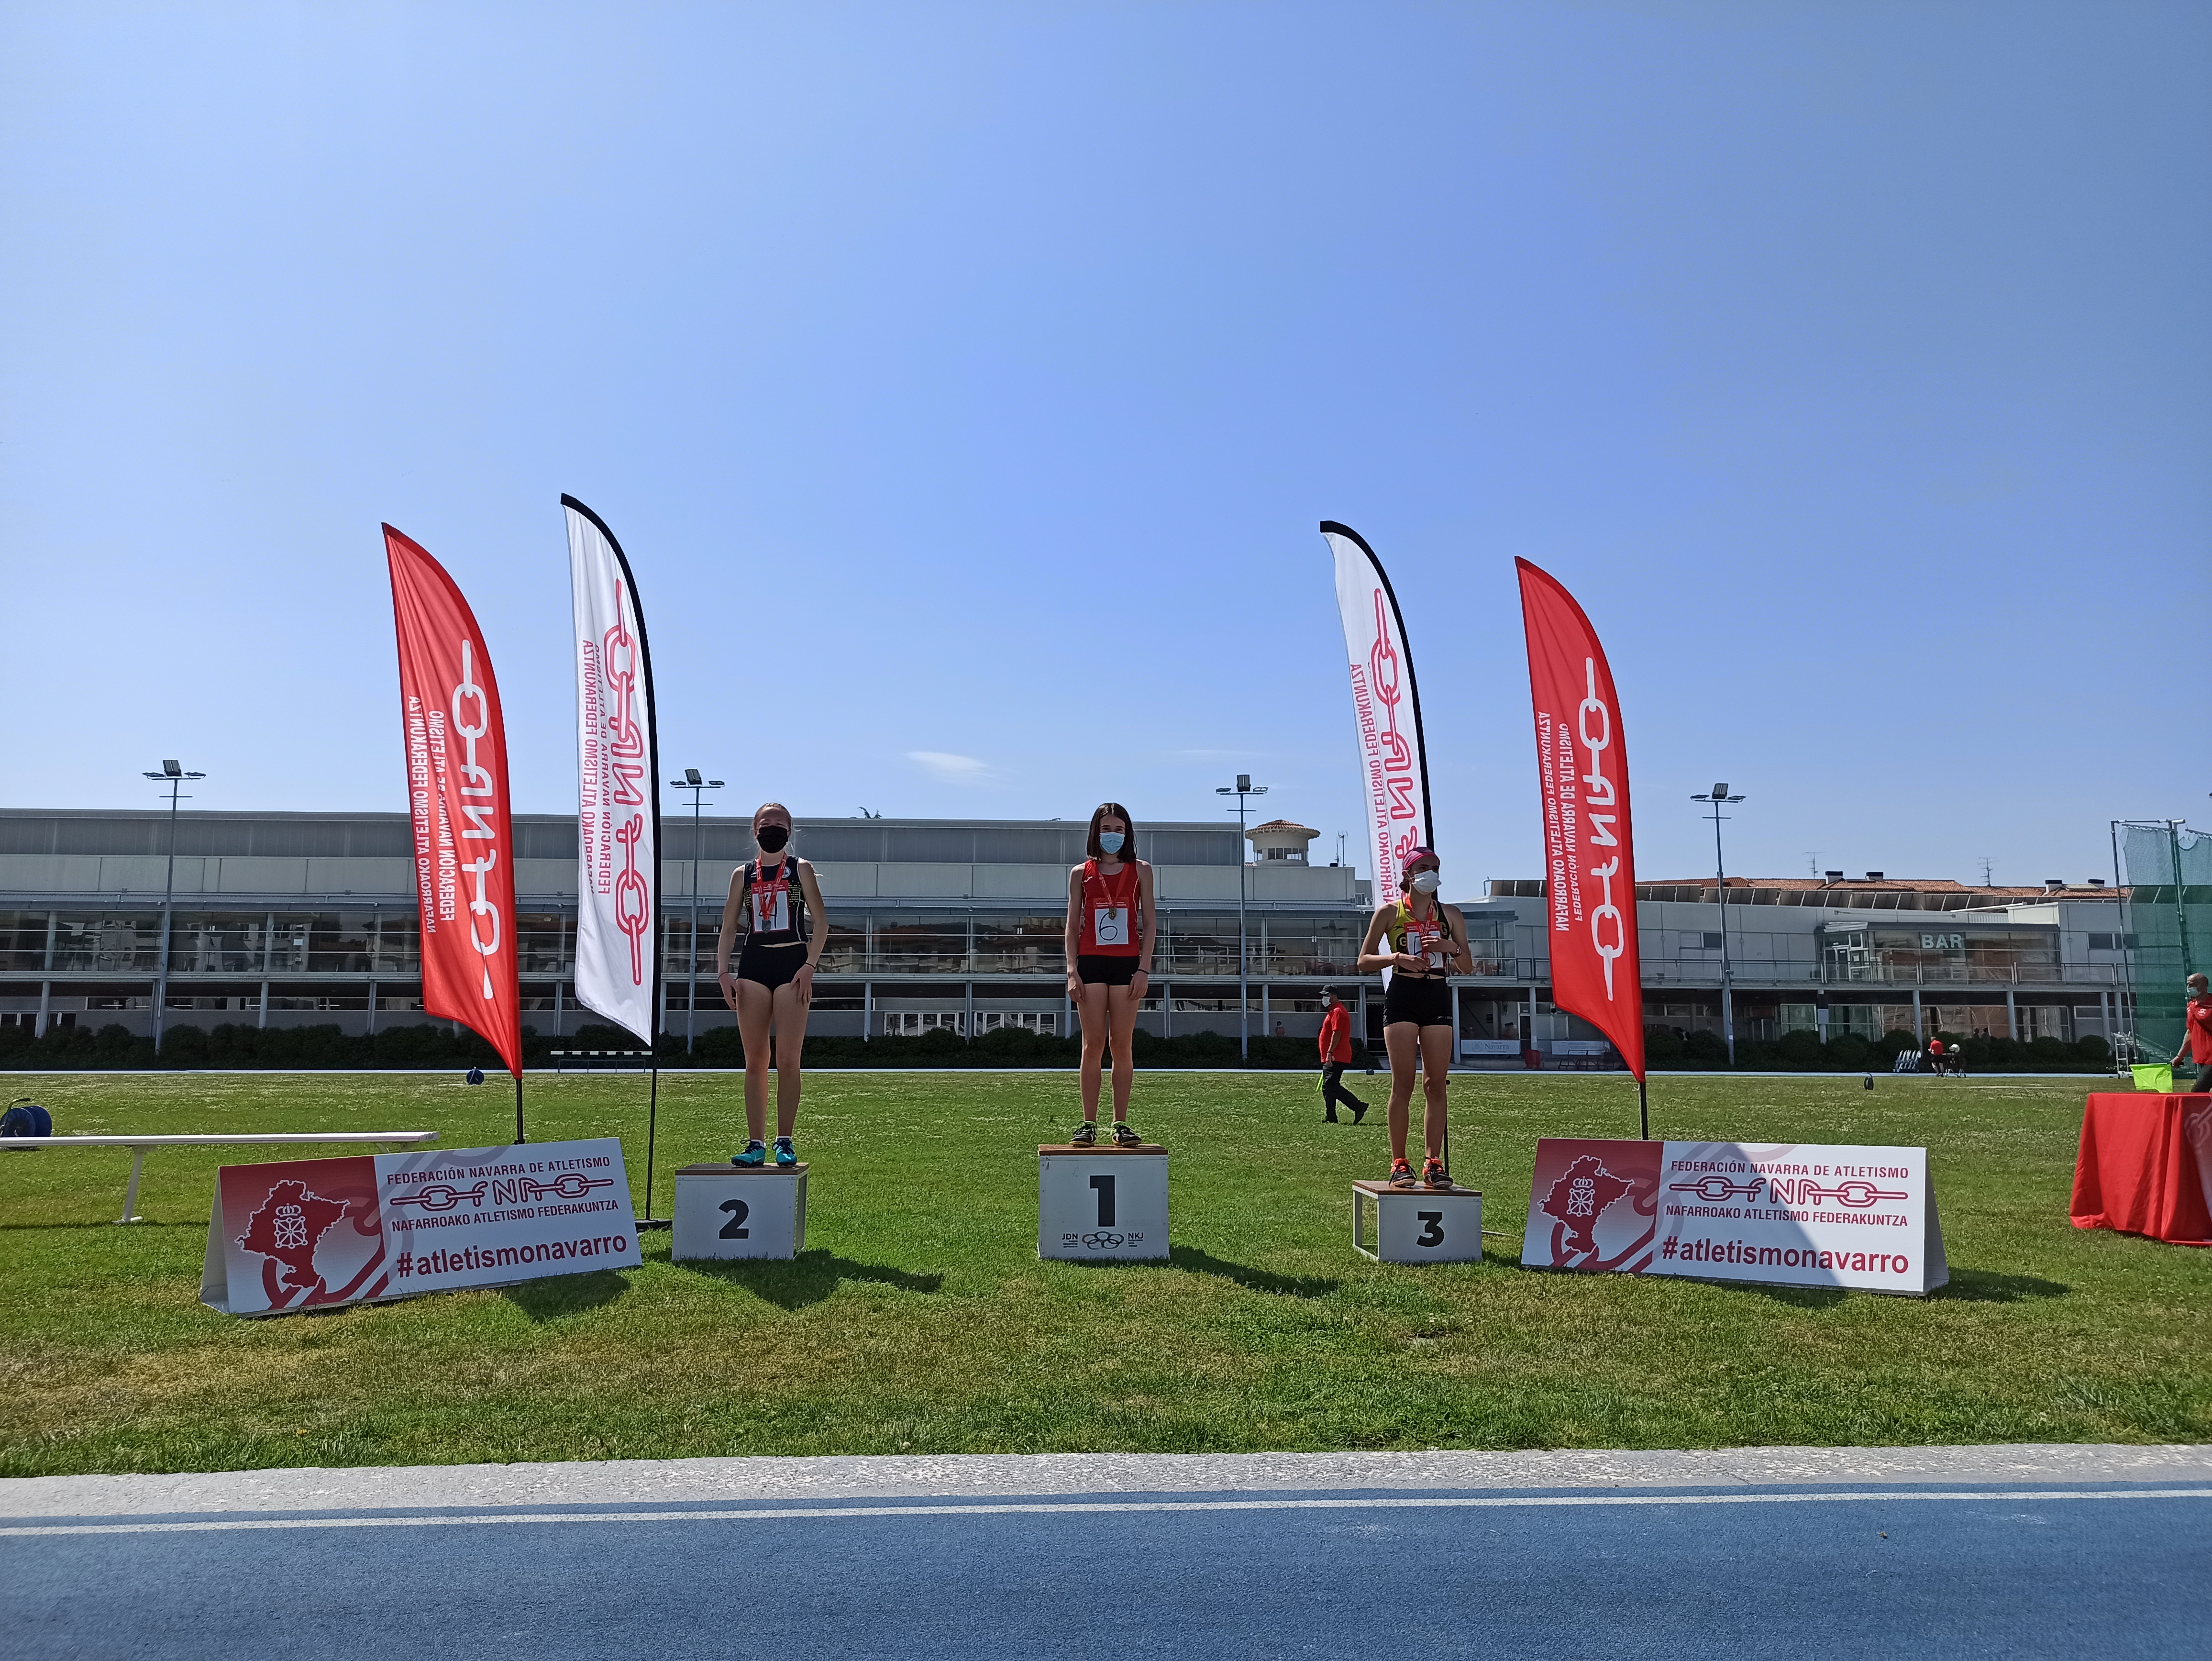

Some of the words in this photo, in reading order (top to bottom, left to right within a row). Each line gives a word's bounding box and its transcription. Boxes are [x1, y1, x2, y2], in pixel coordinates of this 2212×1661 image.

[1099, 911, 1117, 941] 6
[1922, 934, 1962, 948] BAR
[387, 1167, 465, 1185] FEDERACIÓN
[469, 1163, 525, 1178] NAVARRA
[529, 1162, 544, 1173] DE
[548, 1156, 610, 1171] ATLETISMO
[1671, 1160, 1745, 1173] FEDERACIÓN
[1750, 1163, 1808, 1175] NAVARRA
[1814, 1165, 1829, 1175] DE
[1834, 1166, 1908, 1178] ATLETISMO
[392, 1214, 470, 1231] NAFARROAKO
[474, 1207, 535, 1224] ATLETISMO
[538, 1200, 619, 1217] FEDERAKUNTZA
[1090, 1175, 1115, 1227] 1
[1666, 1205, 1740, 1218] NAFARROAKO
[1744, 1208, 1809, 1221] ATLETISMO
[1813, 1211, 1908, 1226] FEDERAKUNTZA
[719, 1199, 749, 1239] 2
[1416, 1211, 1445, 1247] 3
[397, 1235, 627, 1278] #atletismonavarro
[1662, 1236, 1909, 1273] #atletismonavarro
